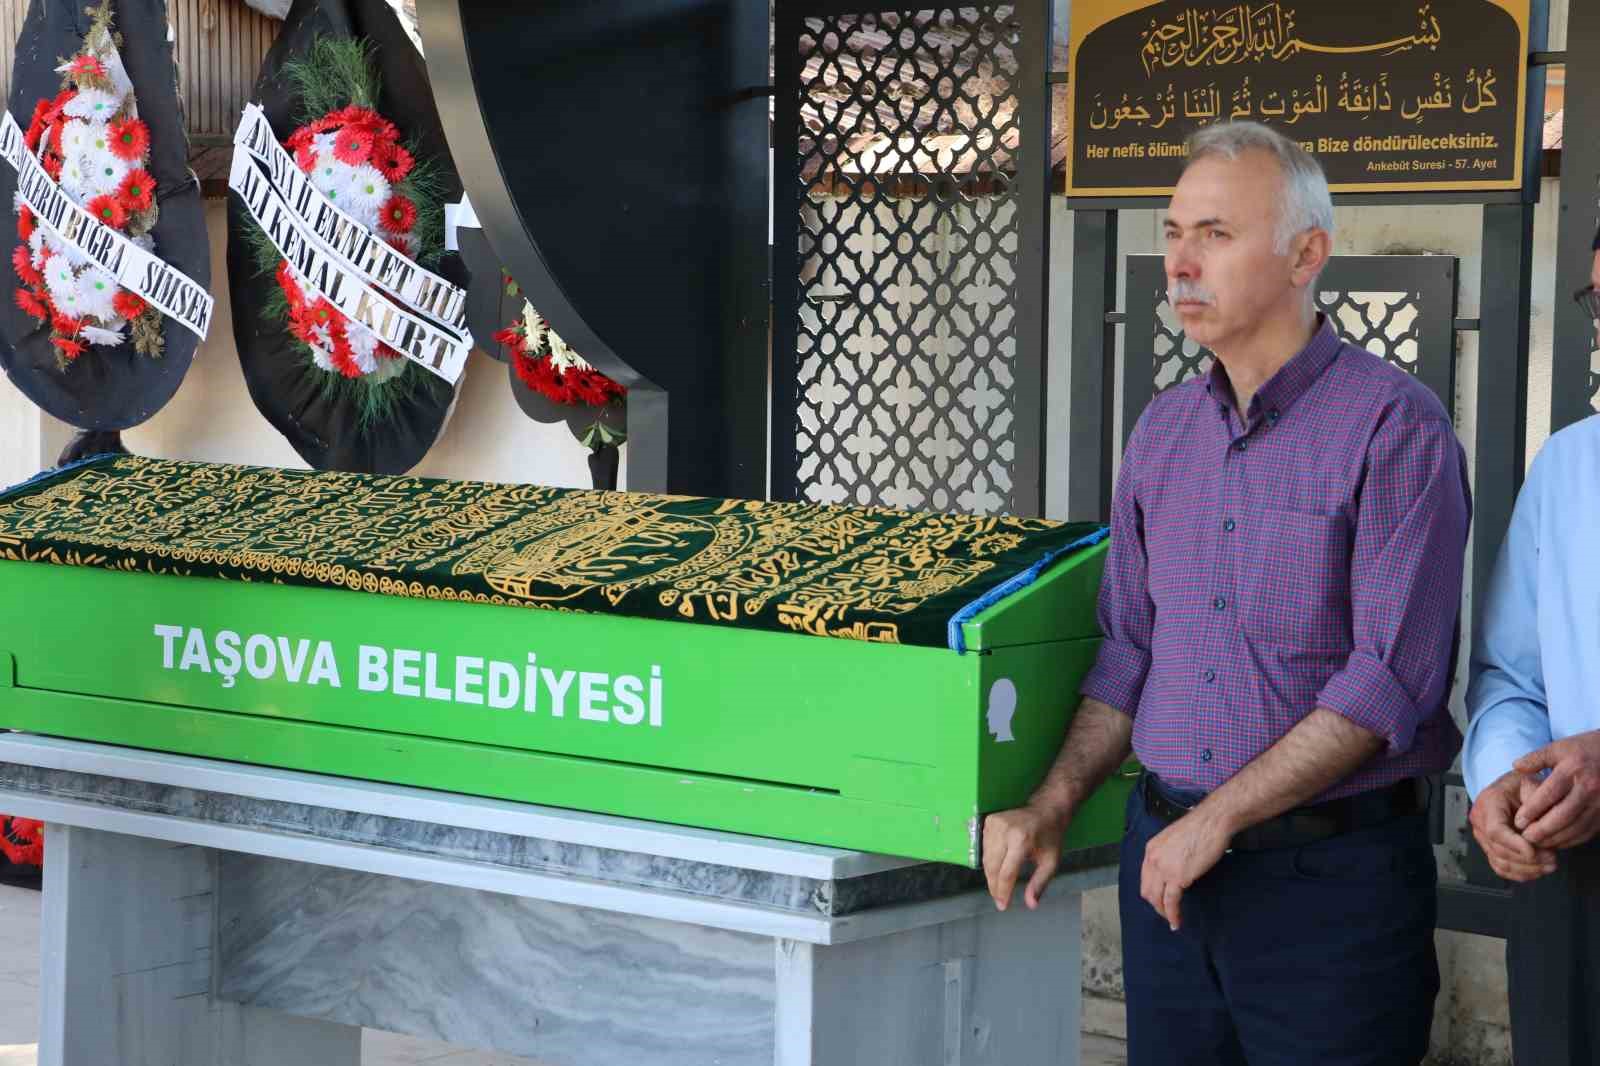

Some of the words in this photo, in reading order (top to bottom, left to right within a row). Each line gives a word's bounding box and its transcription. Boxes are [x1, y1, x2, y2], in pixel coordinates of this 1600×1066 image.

[1086, 143, 1110, 158] Her
[1112, 142, 1145, 158] nefis
[1317, 137, 1349, 153] Bize
[1353, 132, 1498, 152] döndürüleceksiniz.
[1412, 160, 1446, 171] Suresi
[1455, 158, 1470, 169] 57.
[1472, 157, 1497, 171] Ayet
[63, 207, 126, 275] BUĞRA
[139, 260, 210, 332] ŞİMŞEK
[237, 164, 273, 221] ALİ
[269, 205, 347, 308] KEMAL
[354, 289, 457, 370] KURT
[313, 201, 416, 296] EMNİYET
[153, 623, 342, 689] TAŞOVA
[357, 644, 664, 728] BELEDİYESİ
